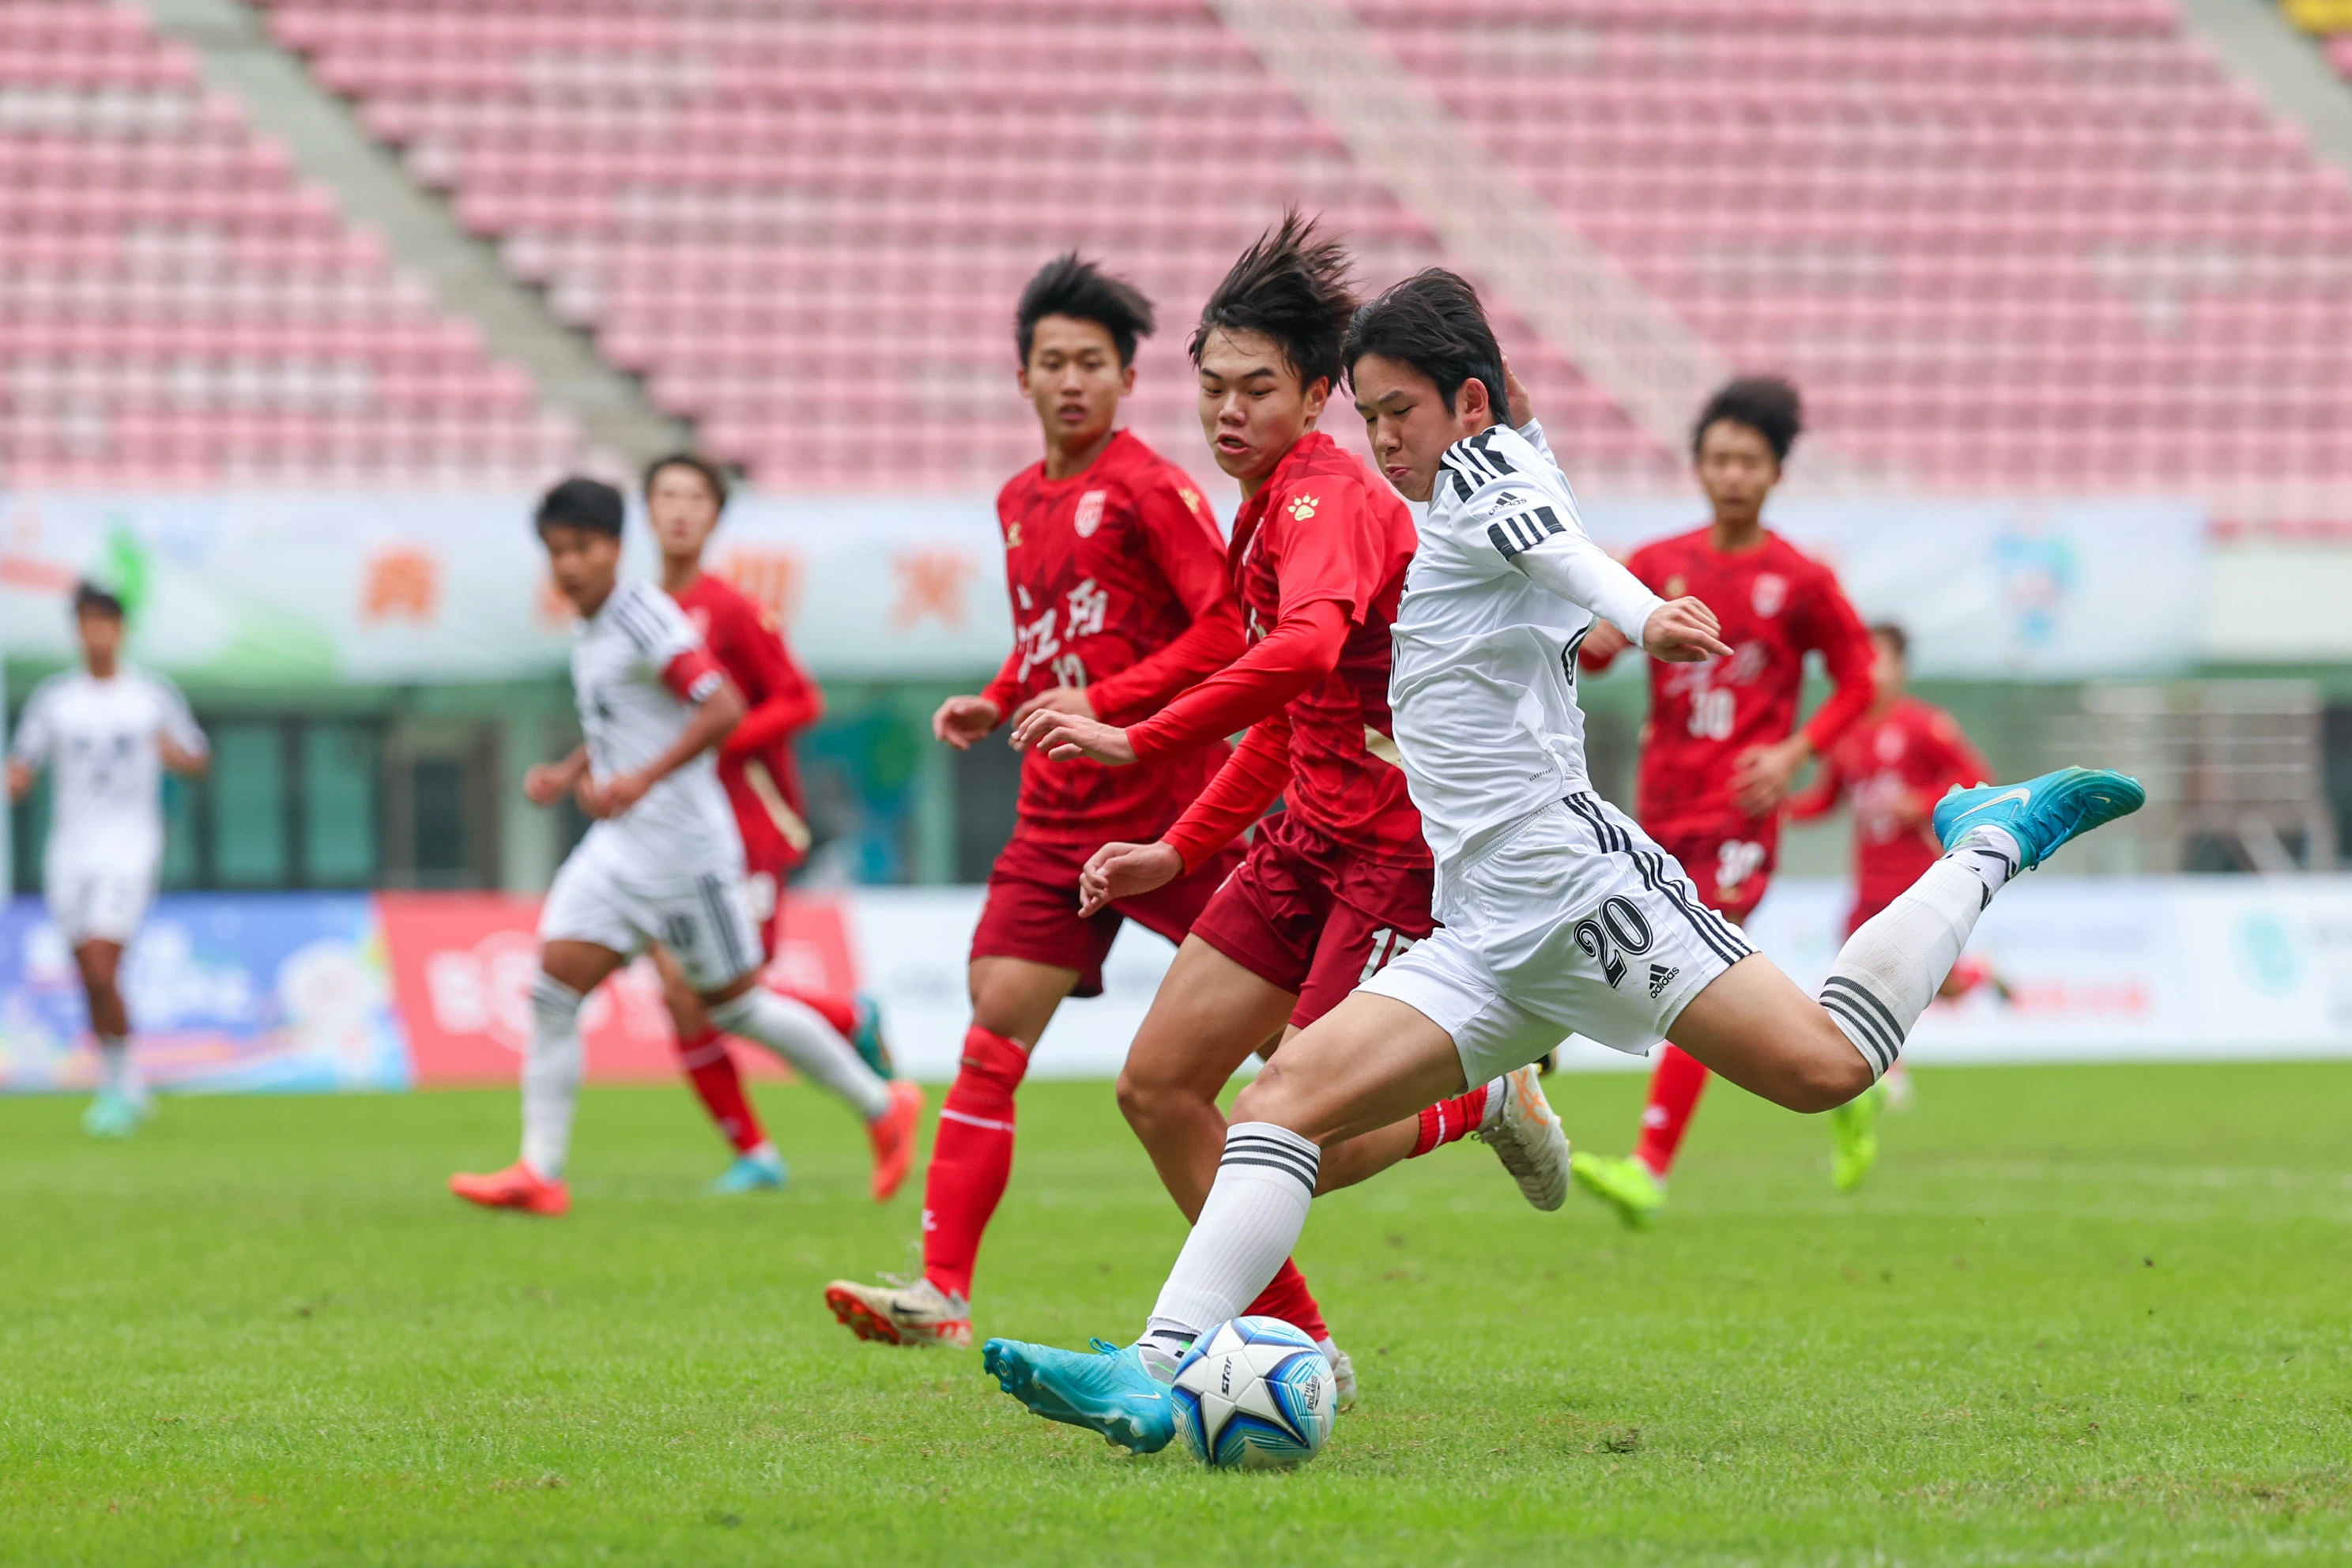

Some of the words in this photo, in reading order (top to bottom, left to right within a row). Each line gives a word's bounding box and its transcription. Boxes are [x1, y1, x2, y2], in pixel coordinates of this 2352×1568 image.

[1687, 687, 1737, 741] 30
[1574, 895, 1653, 989] 20
[1650, 967, 1680, 999] adidas
